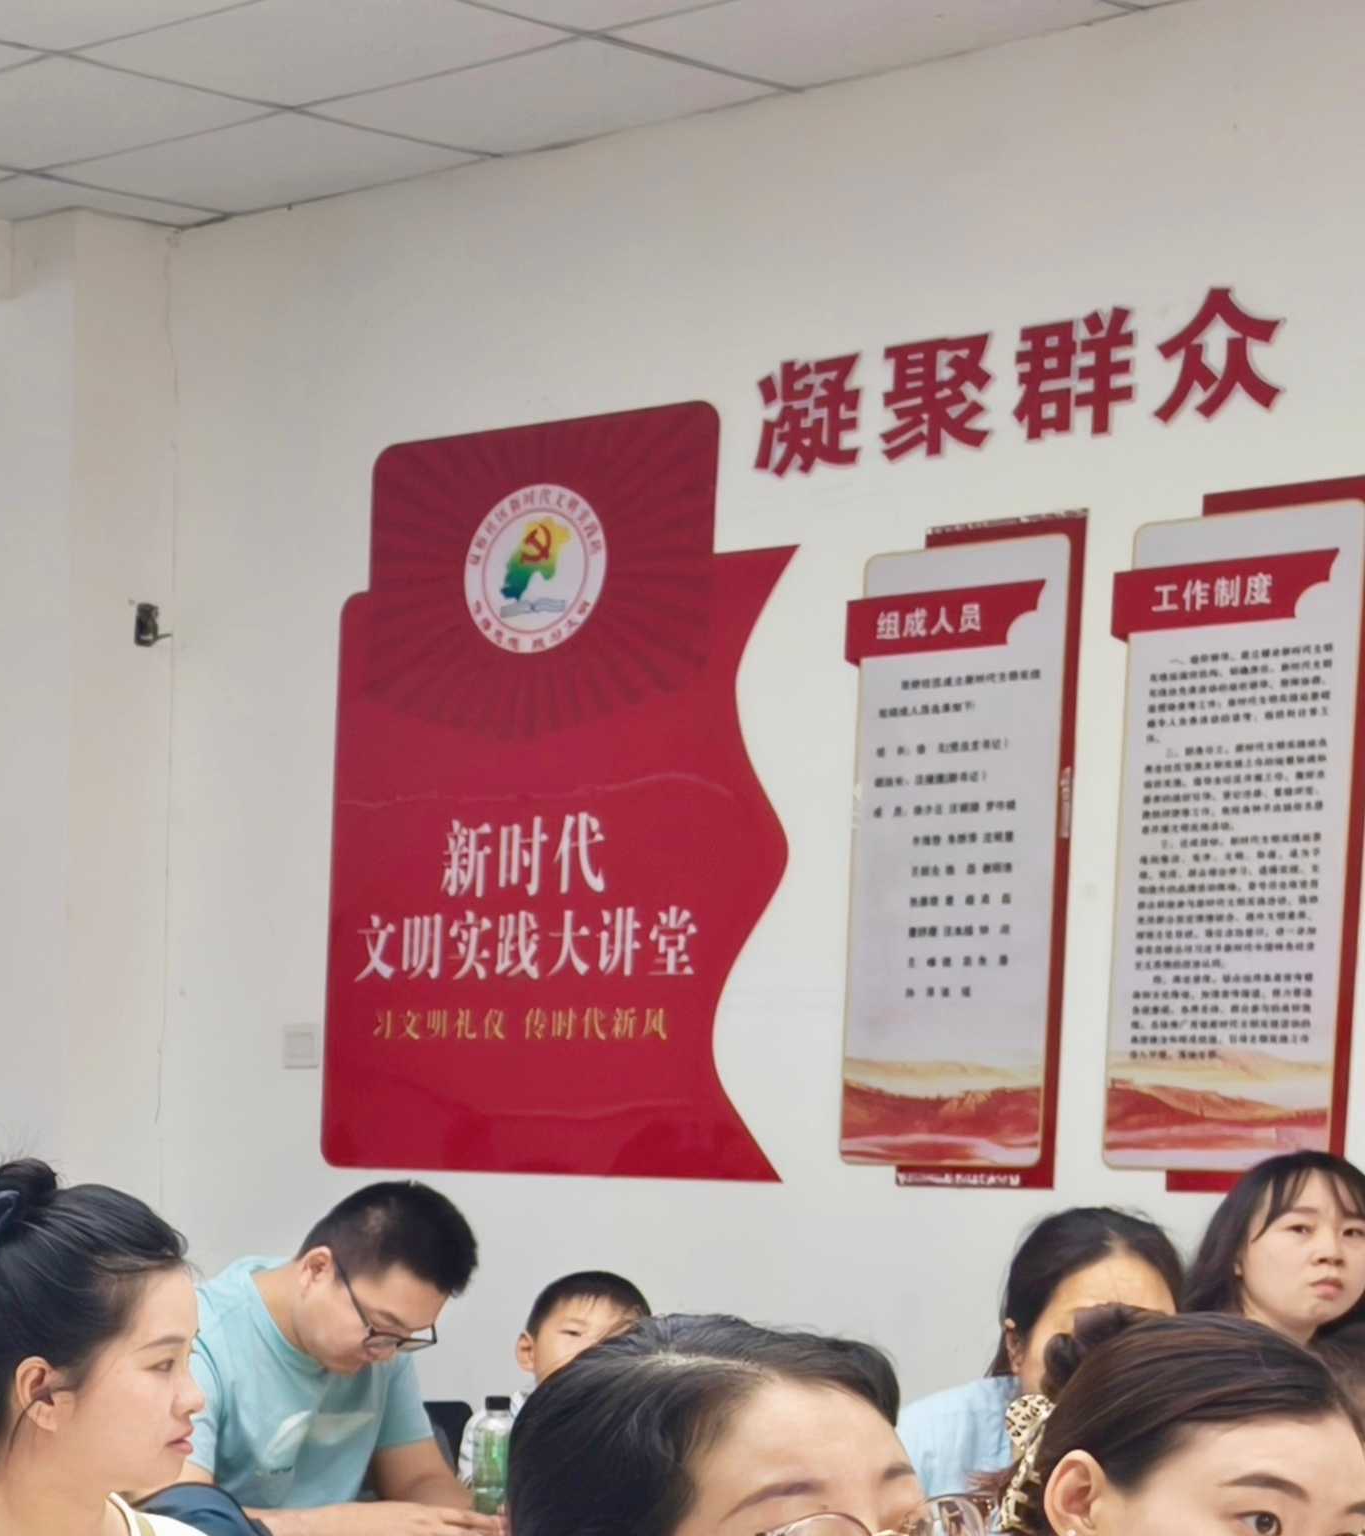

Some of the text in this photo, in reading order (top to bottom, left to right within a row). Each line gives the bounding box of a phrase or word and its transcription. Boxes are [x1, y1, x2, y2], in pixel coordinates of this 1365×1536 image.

[753, 286, 1283, 477] 凝聚群众
[876, 603, 981, 639] 组成人员
[1151, 572, 1272, 612] 工作制度
[440, 812, 606, 898] 新时代
[353, 906, 697, 983] 文明实践大讲堂
[372, 1007, 668, 1041] 习文明礼仪 传时代新风
